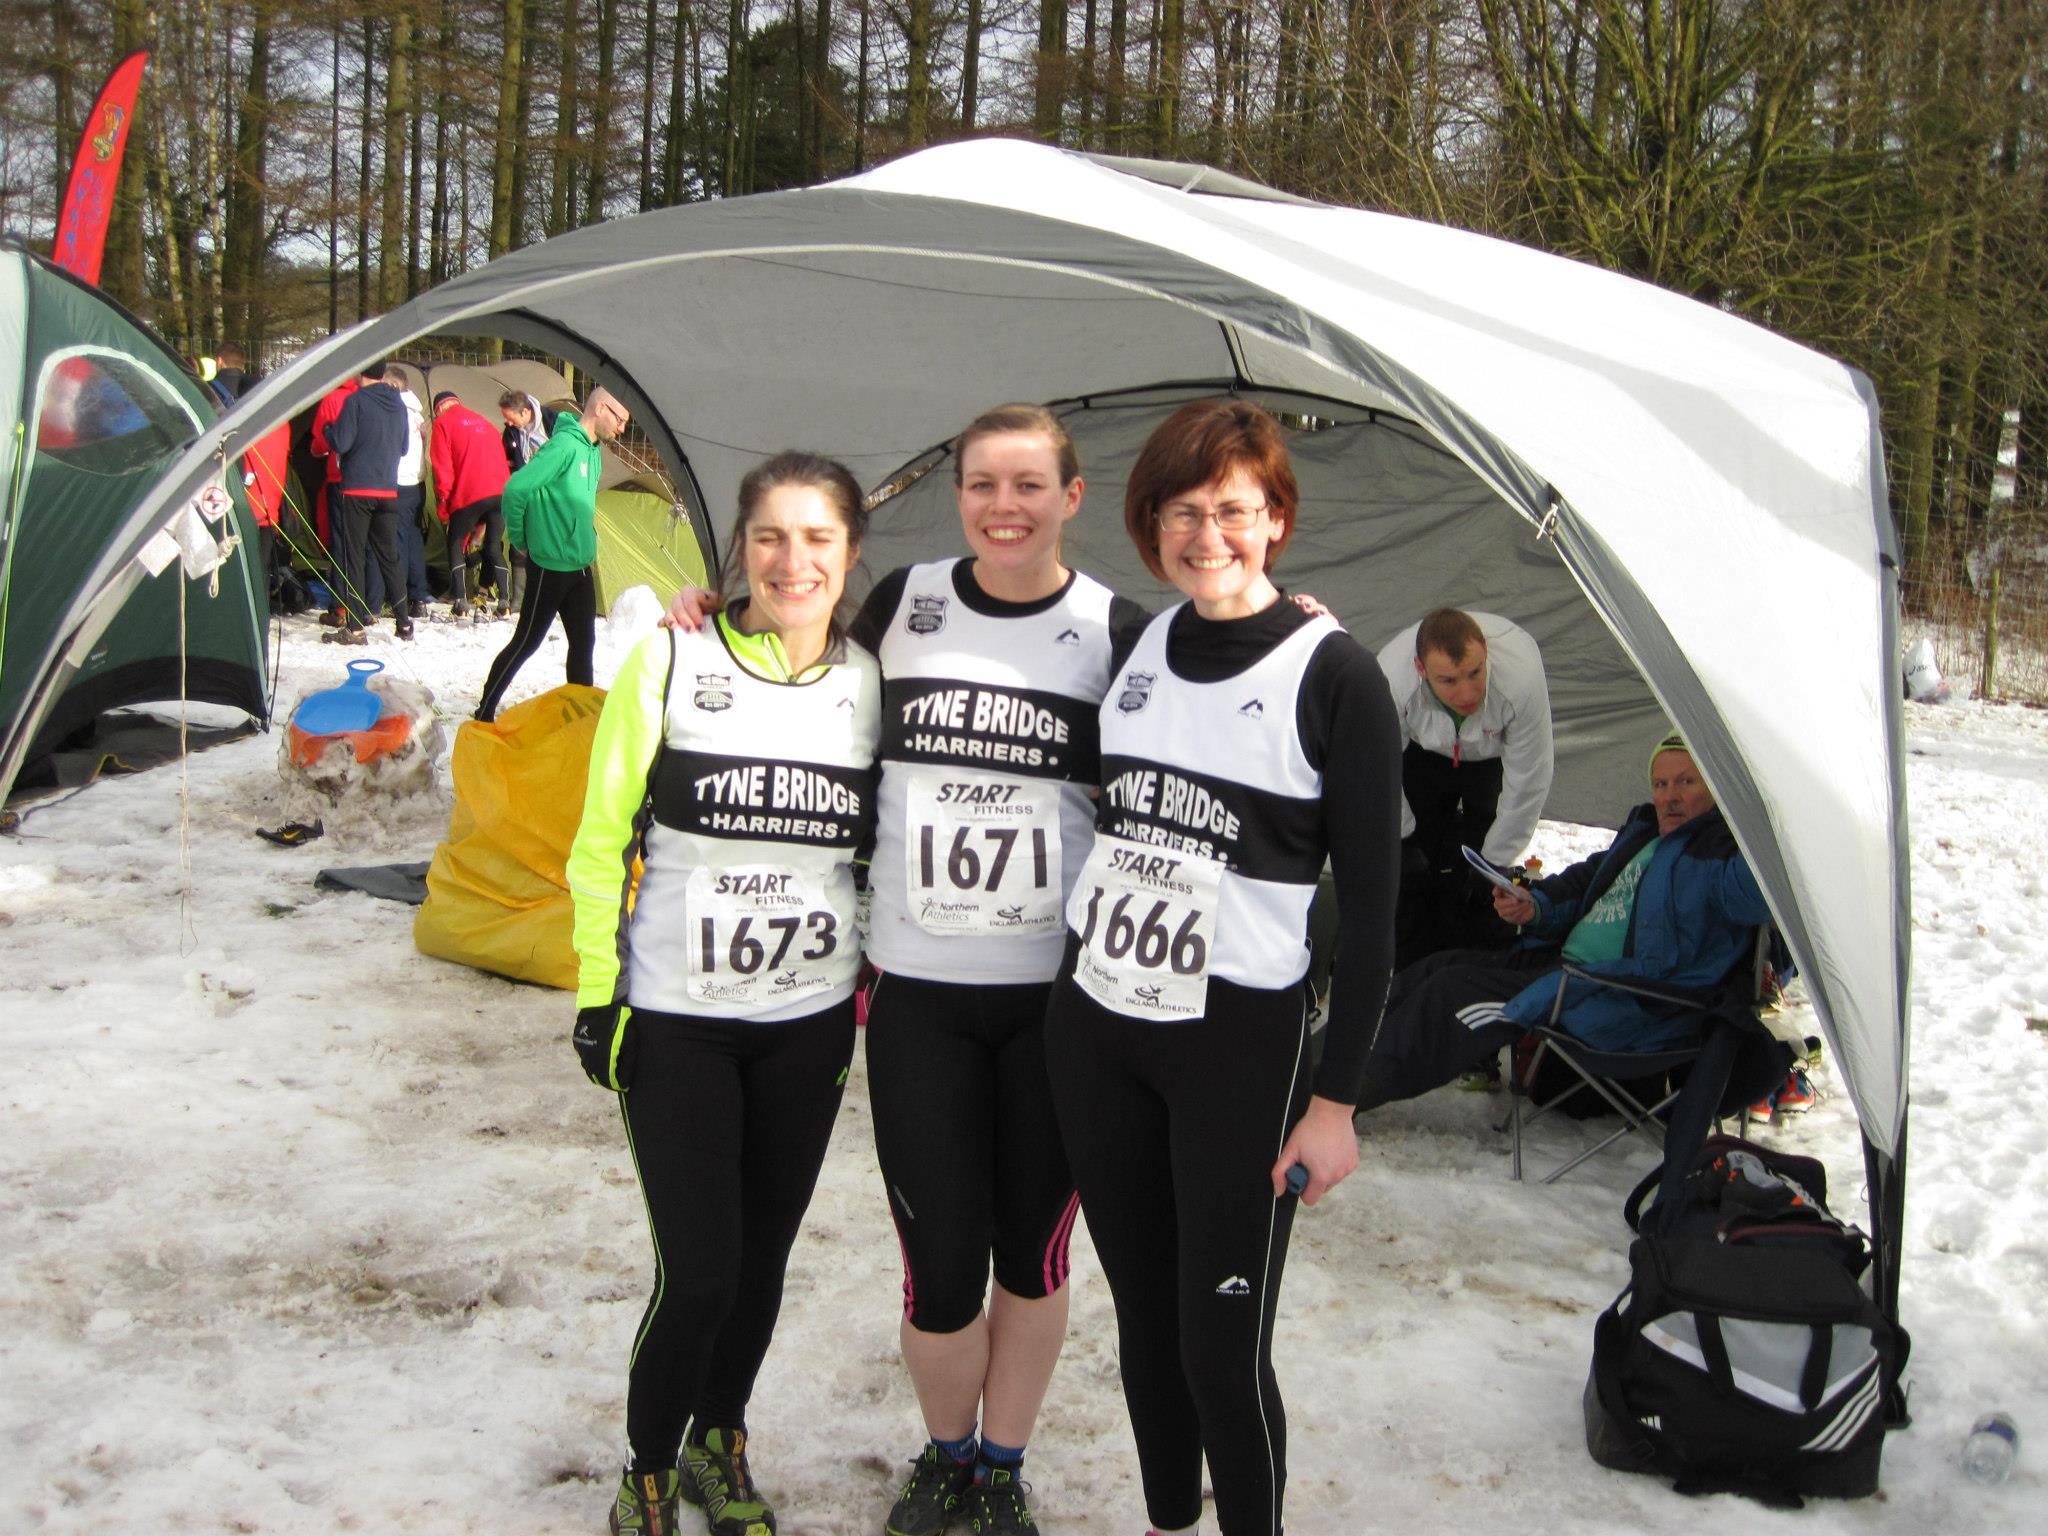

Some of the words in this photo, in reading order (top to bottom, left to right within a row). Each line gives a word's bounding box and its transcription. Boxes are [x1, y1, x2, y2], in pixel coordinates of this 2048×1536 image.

[902, 690, 970, 729] TYNE
[972, 691, 1069, 744] BRIDGE
[915, 733, 1043, 767] HARRIERS
[694, 765, 766, 807] TYNE
[772, 765, 860, 816] BRIDGE
[936, 783, 1022, 804] START
[974, 805, 1034, 815] FITNESS
[1106, 770, 1157, 814] TYNE
[1159, 772, 1241, 841] BRIDGE
[712, 812, 839, 839] HARRIERS
[921, 825, 1047, 892] 1671
[1108, 848, 1182, 880] START
[715, 874, 793, 895] START
[1139, 876, 1193, 895] FITNESS
[755, 895, 805, 906] FITNESS
[940, 902, 980, 912] Northern
[926, 911, 970, 921] Athletics
[702, 911, 838, 975] 1673
[1082, 886, 1206, 975] 1666
[1126, 997, 1157, 1010] ENGLAND
[1159, 1003, 1197, 1015] ATHLETICS
